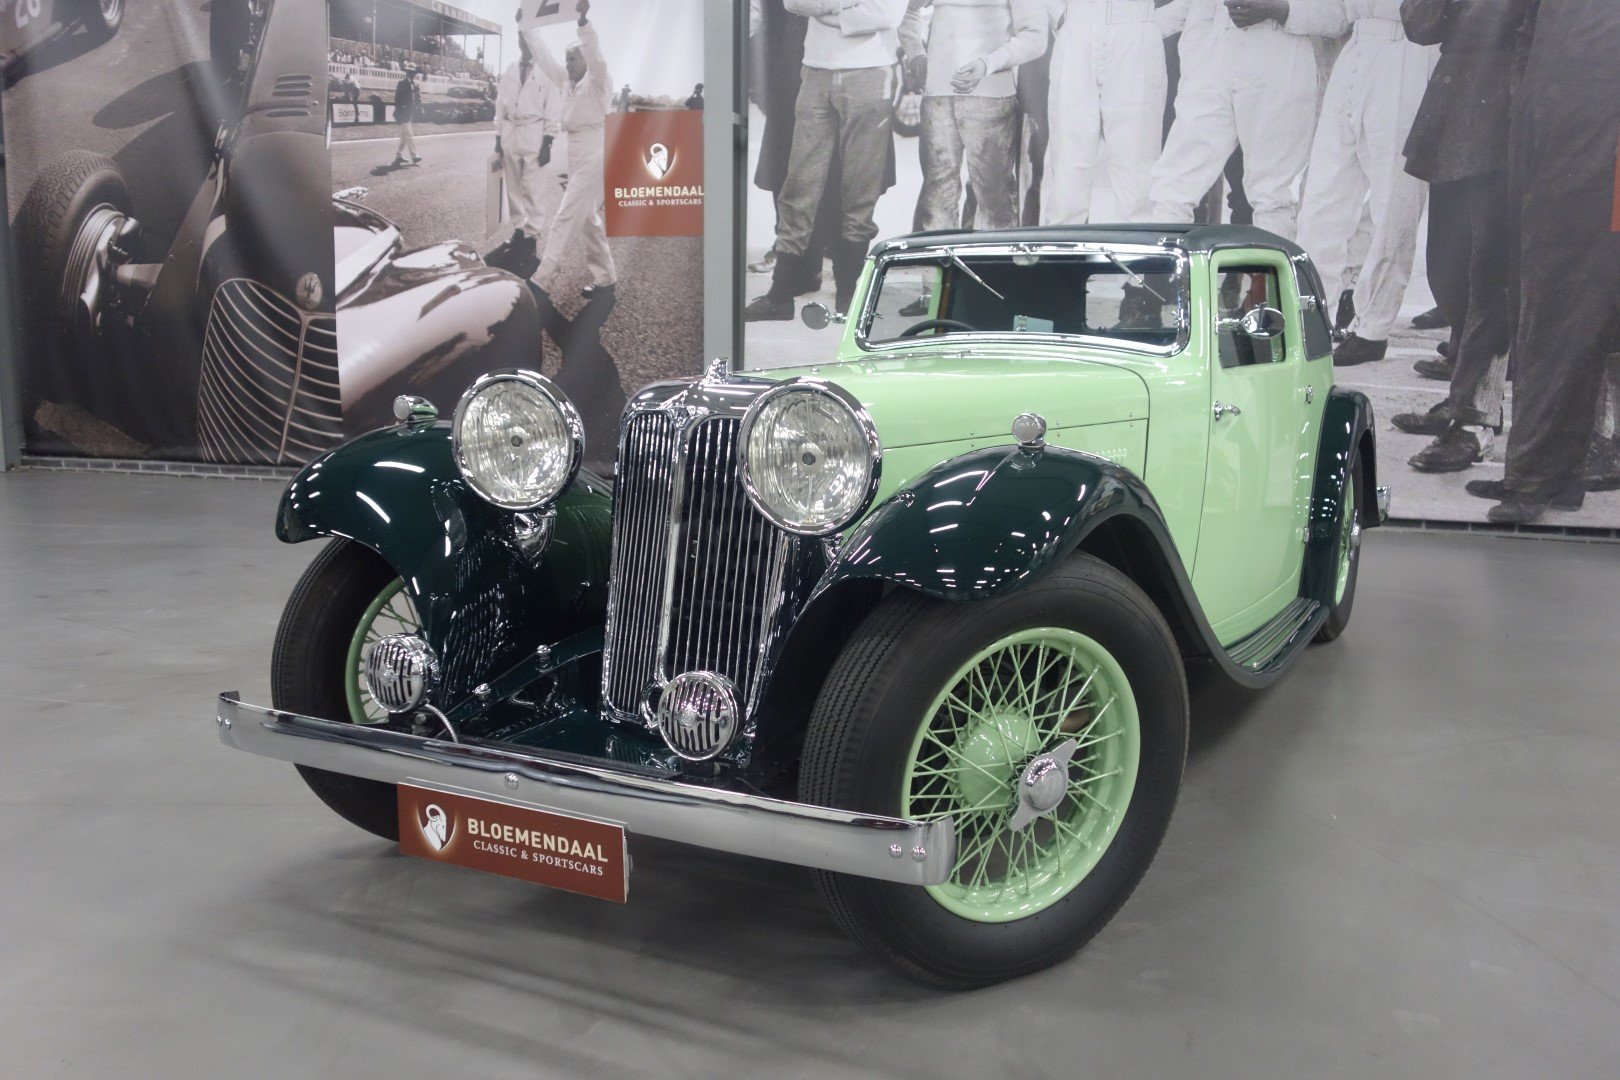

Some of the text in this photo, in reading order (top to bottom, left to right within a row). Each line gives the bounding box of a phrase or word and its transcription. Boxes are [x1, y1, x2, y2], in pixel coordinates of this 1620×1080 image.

[338, 108, 369, 119] Bonms
[614, 185, 704, 198] BLOEMENDAAL
[618, 199, 647, 207] CLASSIC
[656, 198, 702, 206] SPORTSCARS
[467, 817, 608, 863] BLOEMENDAAL
[473, 840, 603, 876] CLASSIC & SPORTSCARS
